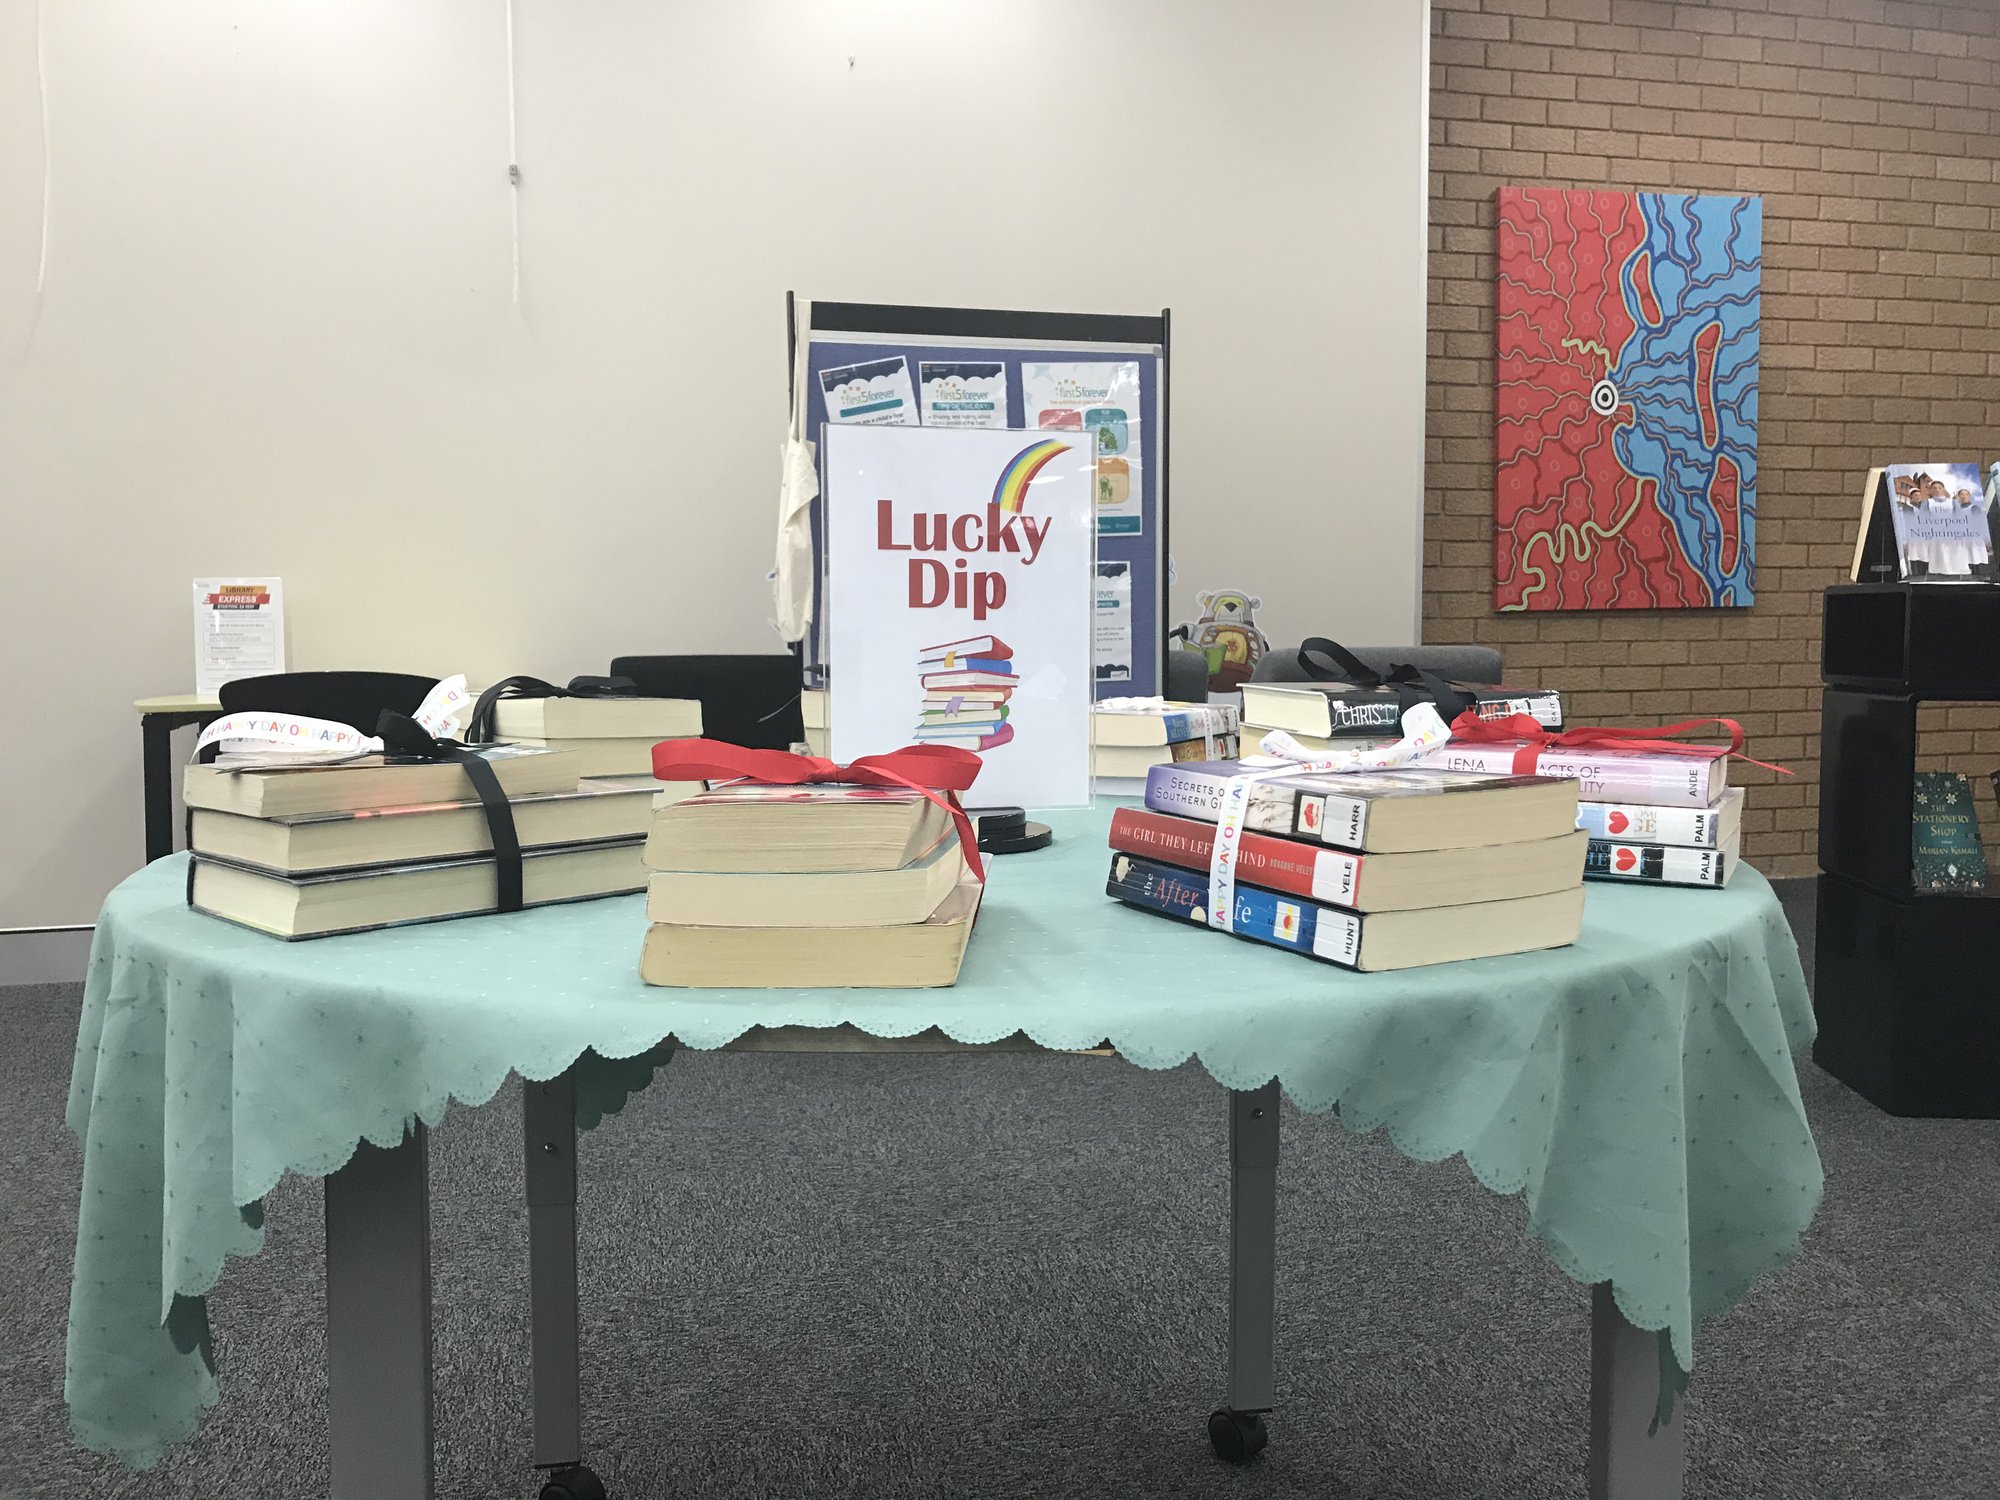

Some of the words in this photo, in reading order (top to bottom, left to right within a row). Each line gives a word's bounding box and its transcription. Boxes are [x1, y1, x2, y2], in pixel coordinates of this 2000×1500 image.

[877, 499, 1053, 565] Lucky
[1910, 528, 1981, 540] Nightingales
[1917, 515, 1969, 528] Liverpool
[218, 595, 257, 604] EXPRESS
[908, 558, 1007, 621] Dip
[261, 721, 286, 732] DAY
[1340, 704, 1382, 726] CHRIS
[1448, 757, 1486, 771] LENA
[1579, 766, 1601, 779] OF
[1171, 776, 1214, 796] SECRETS
[1689, 769, 1698, 797] ANDE
[1155, 787, 1206, 807] SOUTHERN
[1932, 804, 1946, 812] THE
[1349, 804, 1361, 841] HARR
[1694, 814, 1705, 843] PALM
[1912, 812, 1969, 824] STATIONERY
[1930, 825, 1957, 837] SHOP
[1119, 826, 1131, 836] THE
[1133, 827, 1157, 844] GIRL
[1160, 832, 1187, 849] THEY
[1236, 850, 1266, 868] HIND
[1296, 864, 1314, 876] VELET
[1218, 844, 1230, 875] DAY
[1341, 861, 1353, 894] VELE
[1700, 852, 1711, 880] PALM
[1144, 872, 1154, 896] the
[1153, 878, 1200, 908] After
[1344, 920, 1355, 955] HUNT
